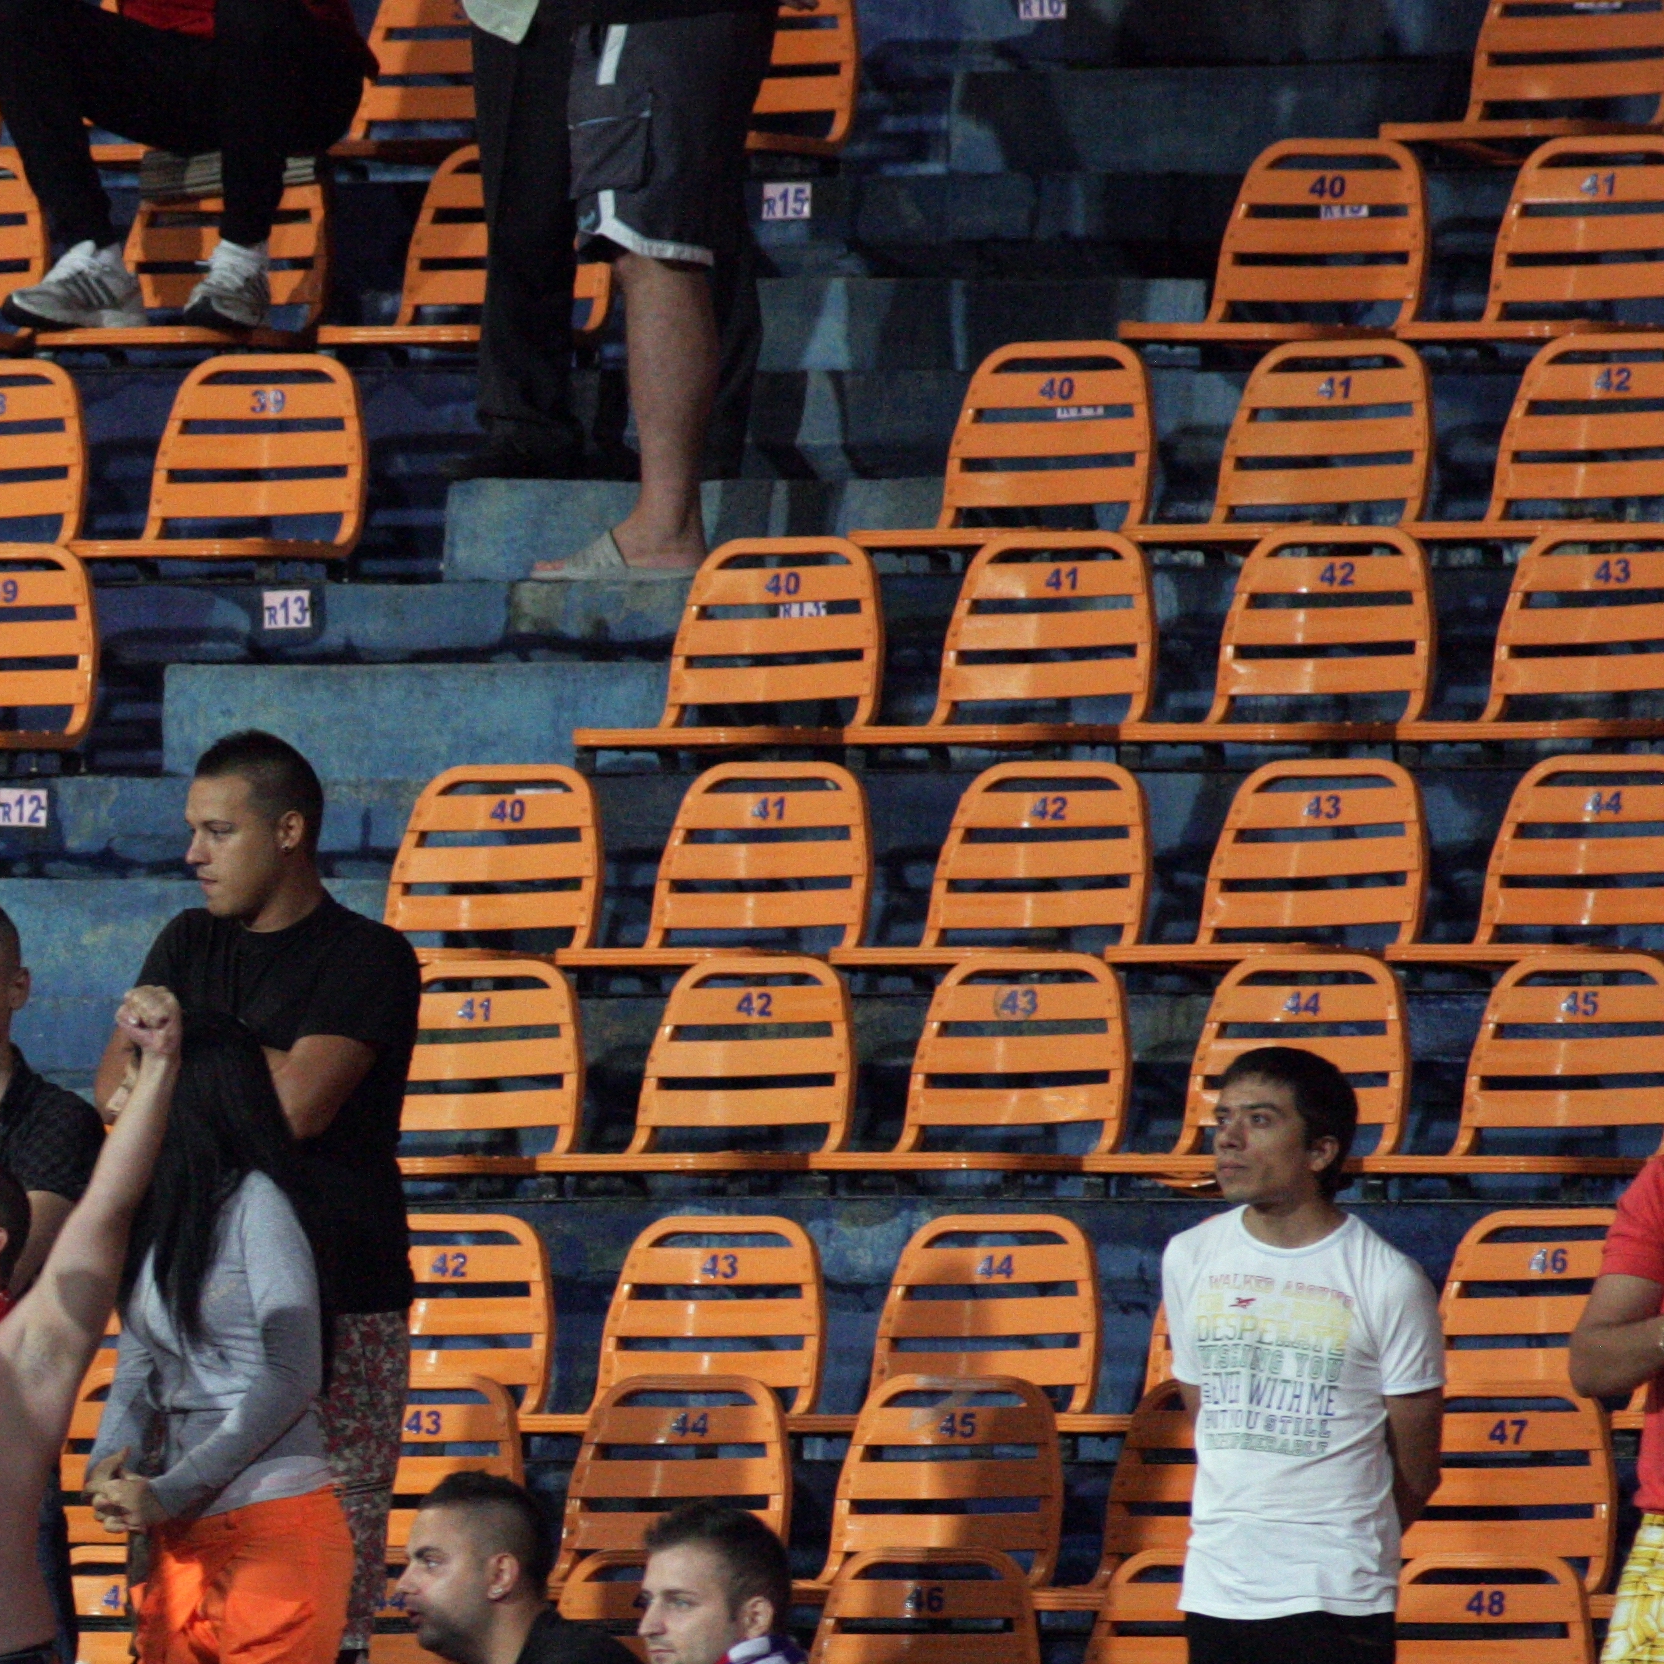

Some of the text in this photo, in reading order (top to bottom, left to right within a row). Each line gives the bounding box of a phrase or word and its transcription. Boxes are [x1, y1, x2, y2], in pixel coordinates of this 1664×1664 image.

[1308, 177, 1344, 199] 40
[1579, 174, 1615, 196] 41
[764, 188, 808, 217] R15
[1038, 378, 1073, 401] 40
[1316, 378, 1351, 399] 41
[1593, 368, 1631, 392] 42
[252, 390, 285, 414] 39
[1044, 568, 1077, 590] 41
[1318, 562, 1354, 587] 42
[1593, 559, 1630, 584] 43
[763, 572, 799, 596] 40
[267, 596, 307, 626] R13
[0, 793, 43, 824] R12
[489, 800, 524, 823] 40
[750, 798, 784, 820] 41
[1029, 797, 1066, 821] 42
[1302, 795, 1340, 819] 43
[1582, 792, 1621, 814] 44
[455, 999, 491, 1022] 41
[736, 993, 771, 1018] 42
[999, 990, 1037, 1016] 43
[1281, 993, 1320, 1015] 44
[1558, 992, 1597, 1017] 45
[429, 1253, 467, 1278] 42
[699, 1254, 737, 1279] 43
[974, 1256, 1013, 1278] 44
[1528, 1249, 1566, 1274] 46
[402, 1411, 440, 1436] 43
[669, 1413, 707, 1436] 44
[937, 1412, 975, 1438] 45
[1487, 1419, 1527, 1444] 47
[1465, 1591, 1504, 1617] 48
